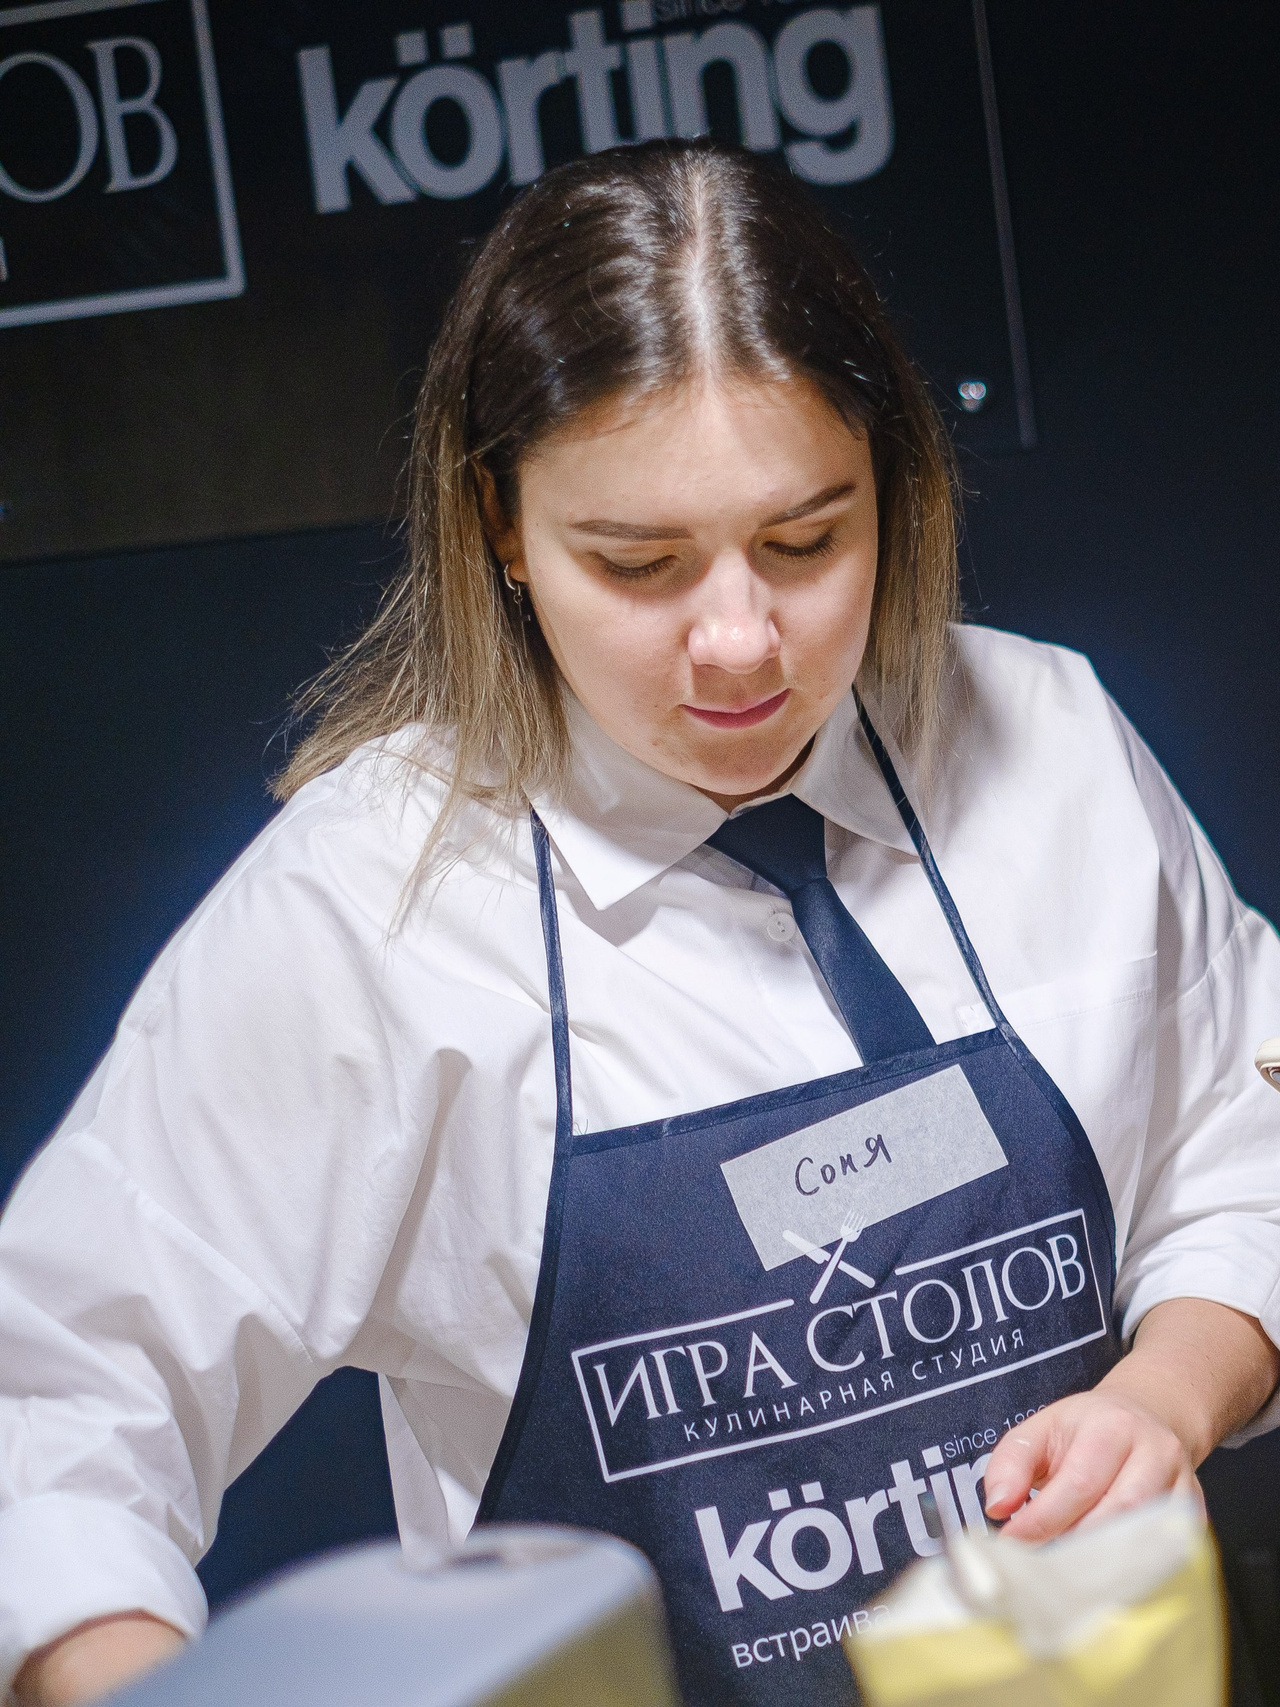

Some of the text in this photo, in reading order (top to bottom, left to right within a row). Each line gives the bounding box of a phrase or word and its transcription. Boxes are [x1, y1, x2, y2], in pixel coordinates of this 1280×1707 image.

[297, 0, 895, 214] körting
[794, 1132, 893, 1197] Соня
[594, 1233, 1086, 1427] ИГРА СТОЛОВ
[684, 1328, 1025, 1443] КУЛИНАРНАЯ СТУДИЯ
[943, 1428, 998, 1459] since
